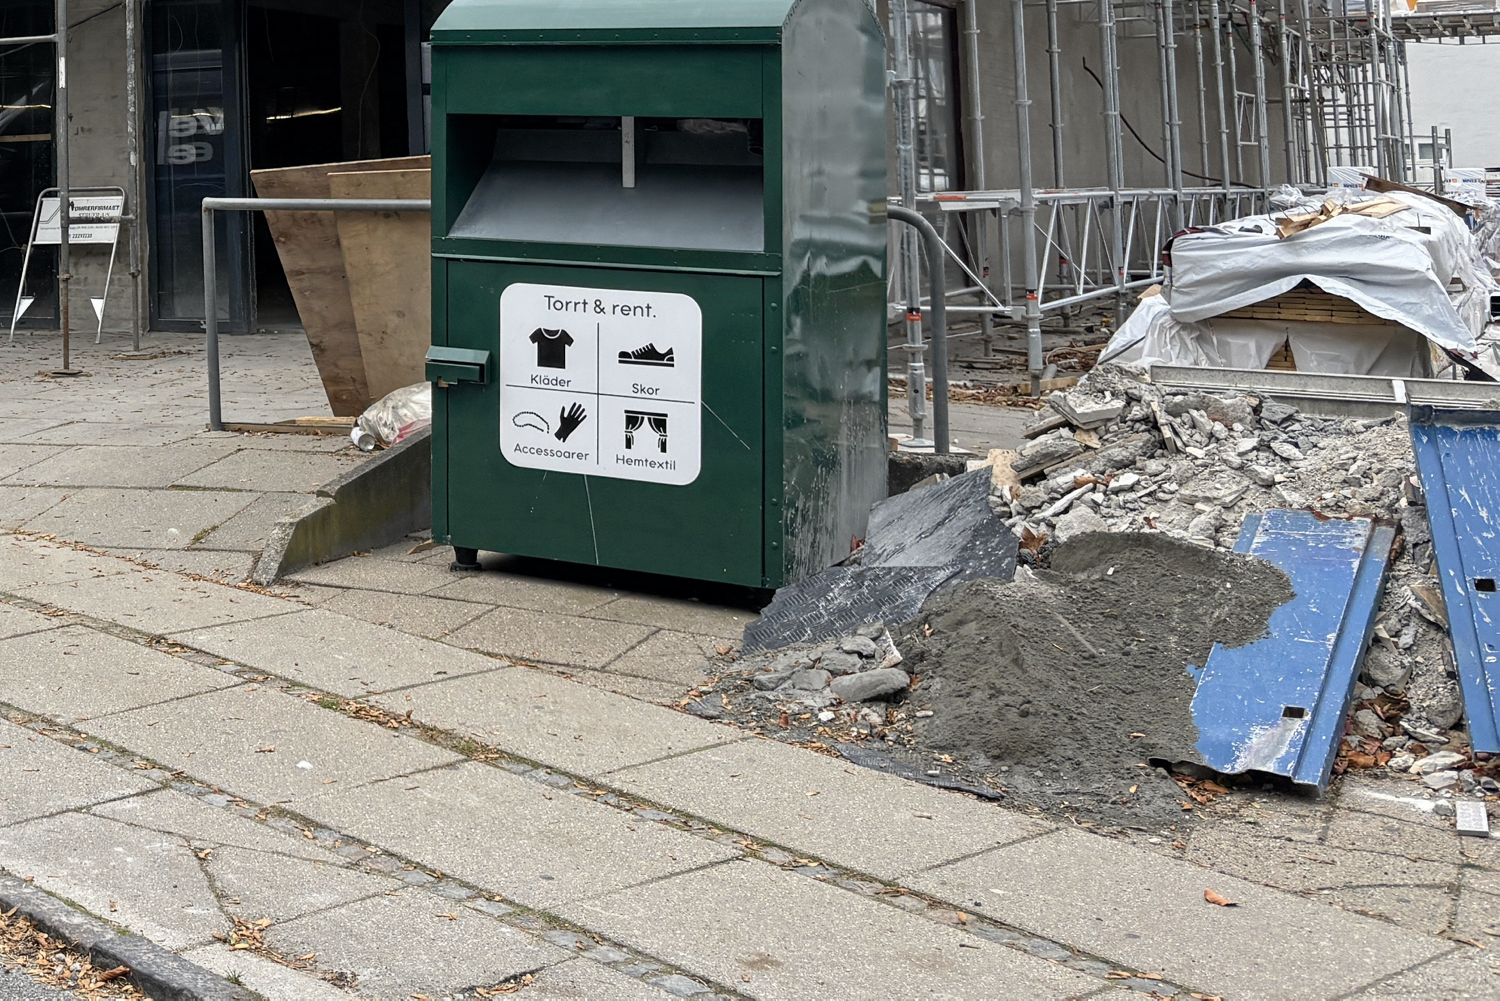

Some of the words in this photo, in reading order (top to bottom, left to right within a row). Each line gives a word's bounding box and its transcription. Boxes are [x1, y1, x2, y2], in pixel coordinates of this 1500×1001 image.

[543, 294, 589, 313] Torrt
[593, 298, 606, 315] &
[612, 302, 657, 319] rent.
[530, 373, 572, 388] Kläder
[631, 382, 661, 396] Skor
[513, 442, 590, 462] Accessoarer
[615, 453, 677, 471] Hemtextil
